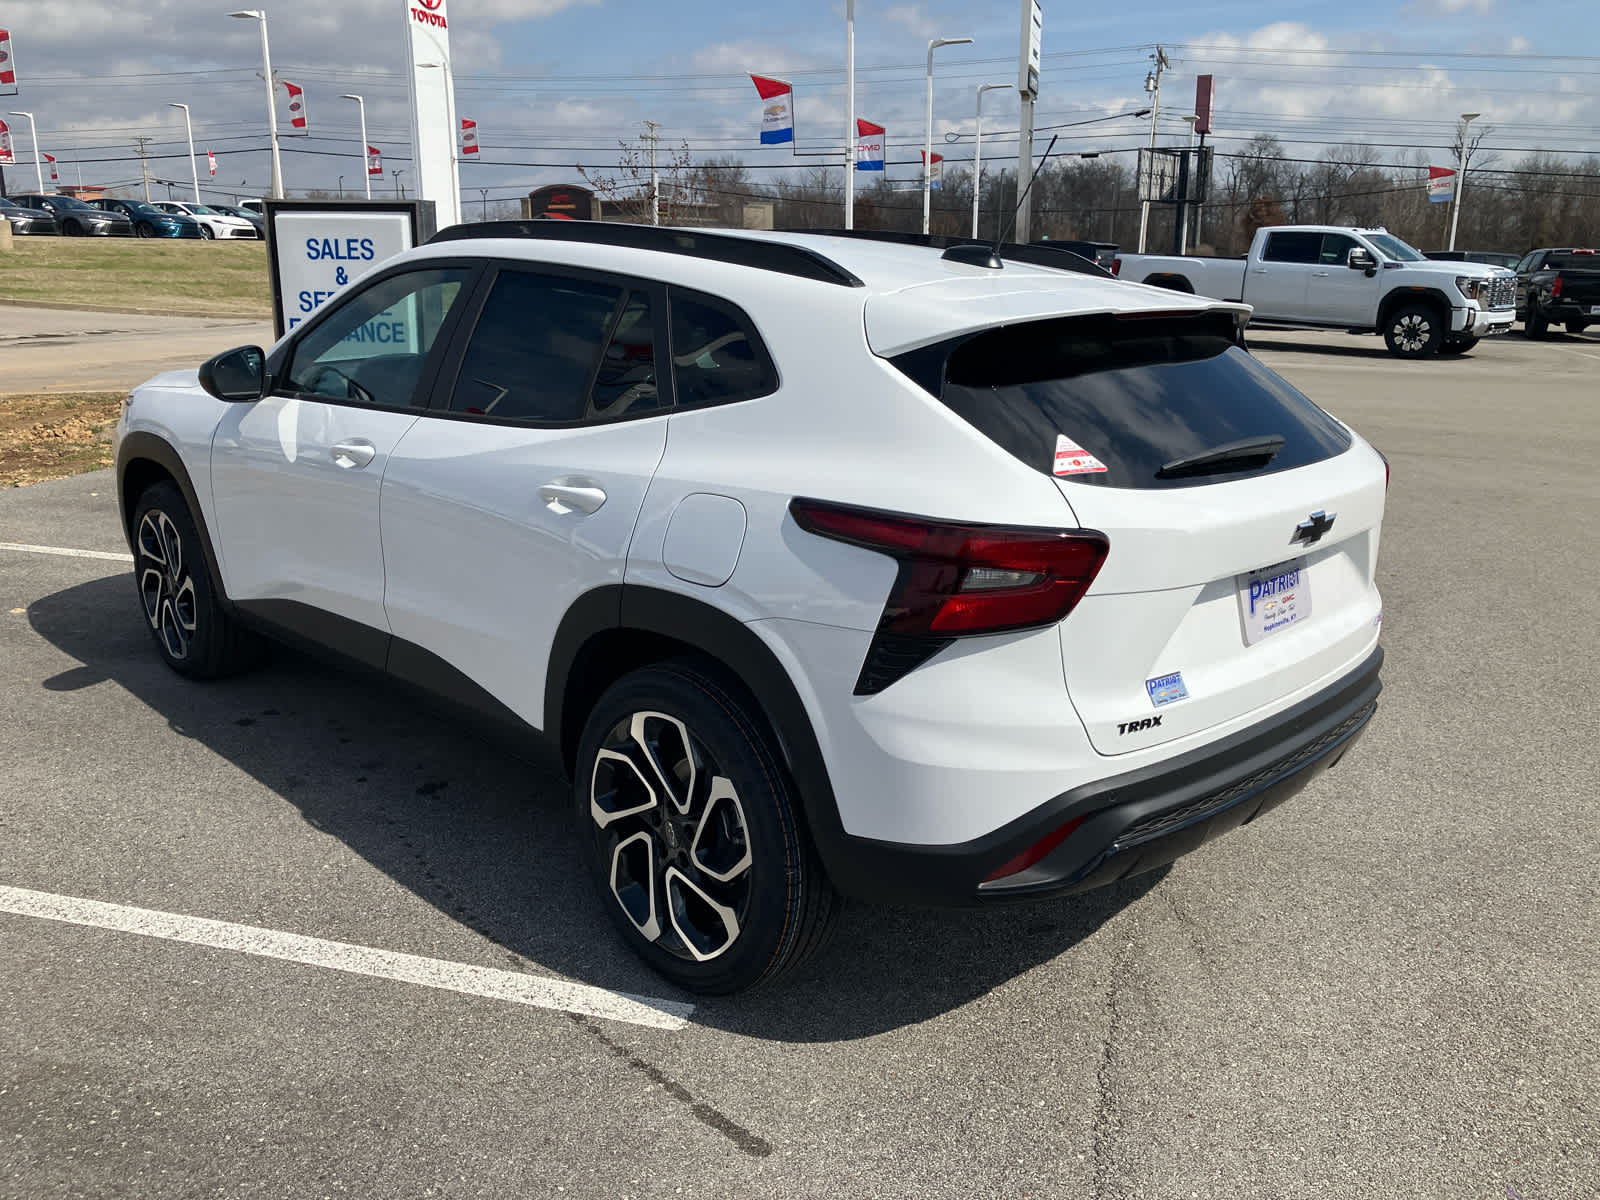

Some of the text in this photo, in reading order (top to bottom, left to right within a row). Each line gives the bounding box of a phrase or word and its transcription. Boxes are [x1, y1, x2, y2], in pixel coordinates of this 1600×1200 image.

[410, 7, 447, 29] TOYOTA
[306, 238, 375, 260] SALES
[335, 266, 348, 286] &
[1249, 567, 1300, 615] PATRIOT
[1149, 674, 1181, 695] PATRIOT
[1117, 714, 1163, 737] TRAX
